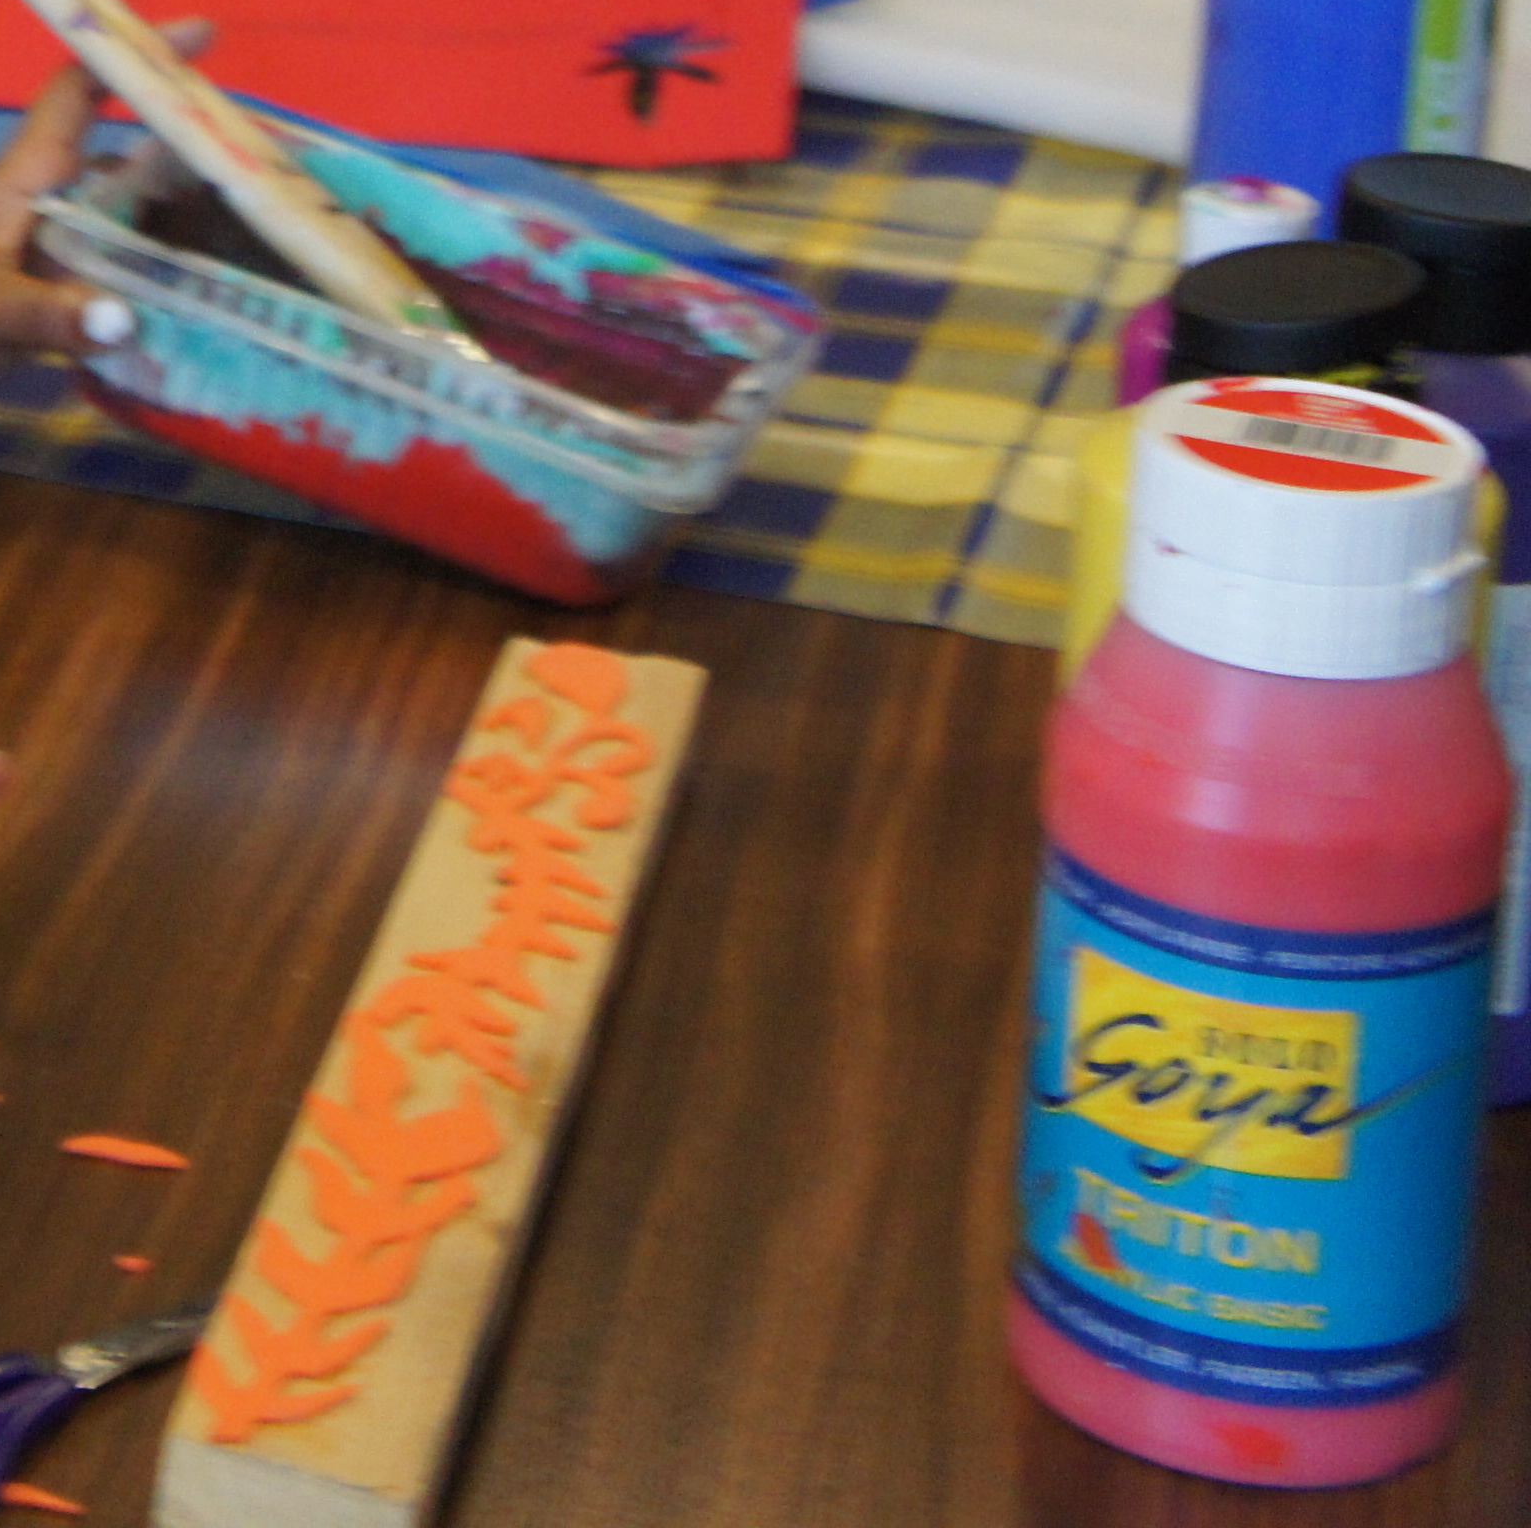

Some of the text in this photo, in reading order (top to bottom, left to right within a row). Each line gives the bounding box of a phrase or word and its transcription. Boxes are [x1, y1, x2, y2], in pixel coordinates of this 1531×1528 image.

[1035, 1012, 1469, 1182] Goya
[1075, 1167, 1322, 1276] TRITON
[1209, 1291, 1331, 1332] BASIC
